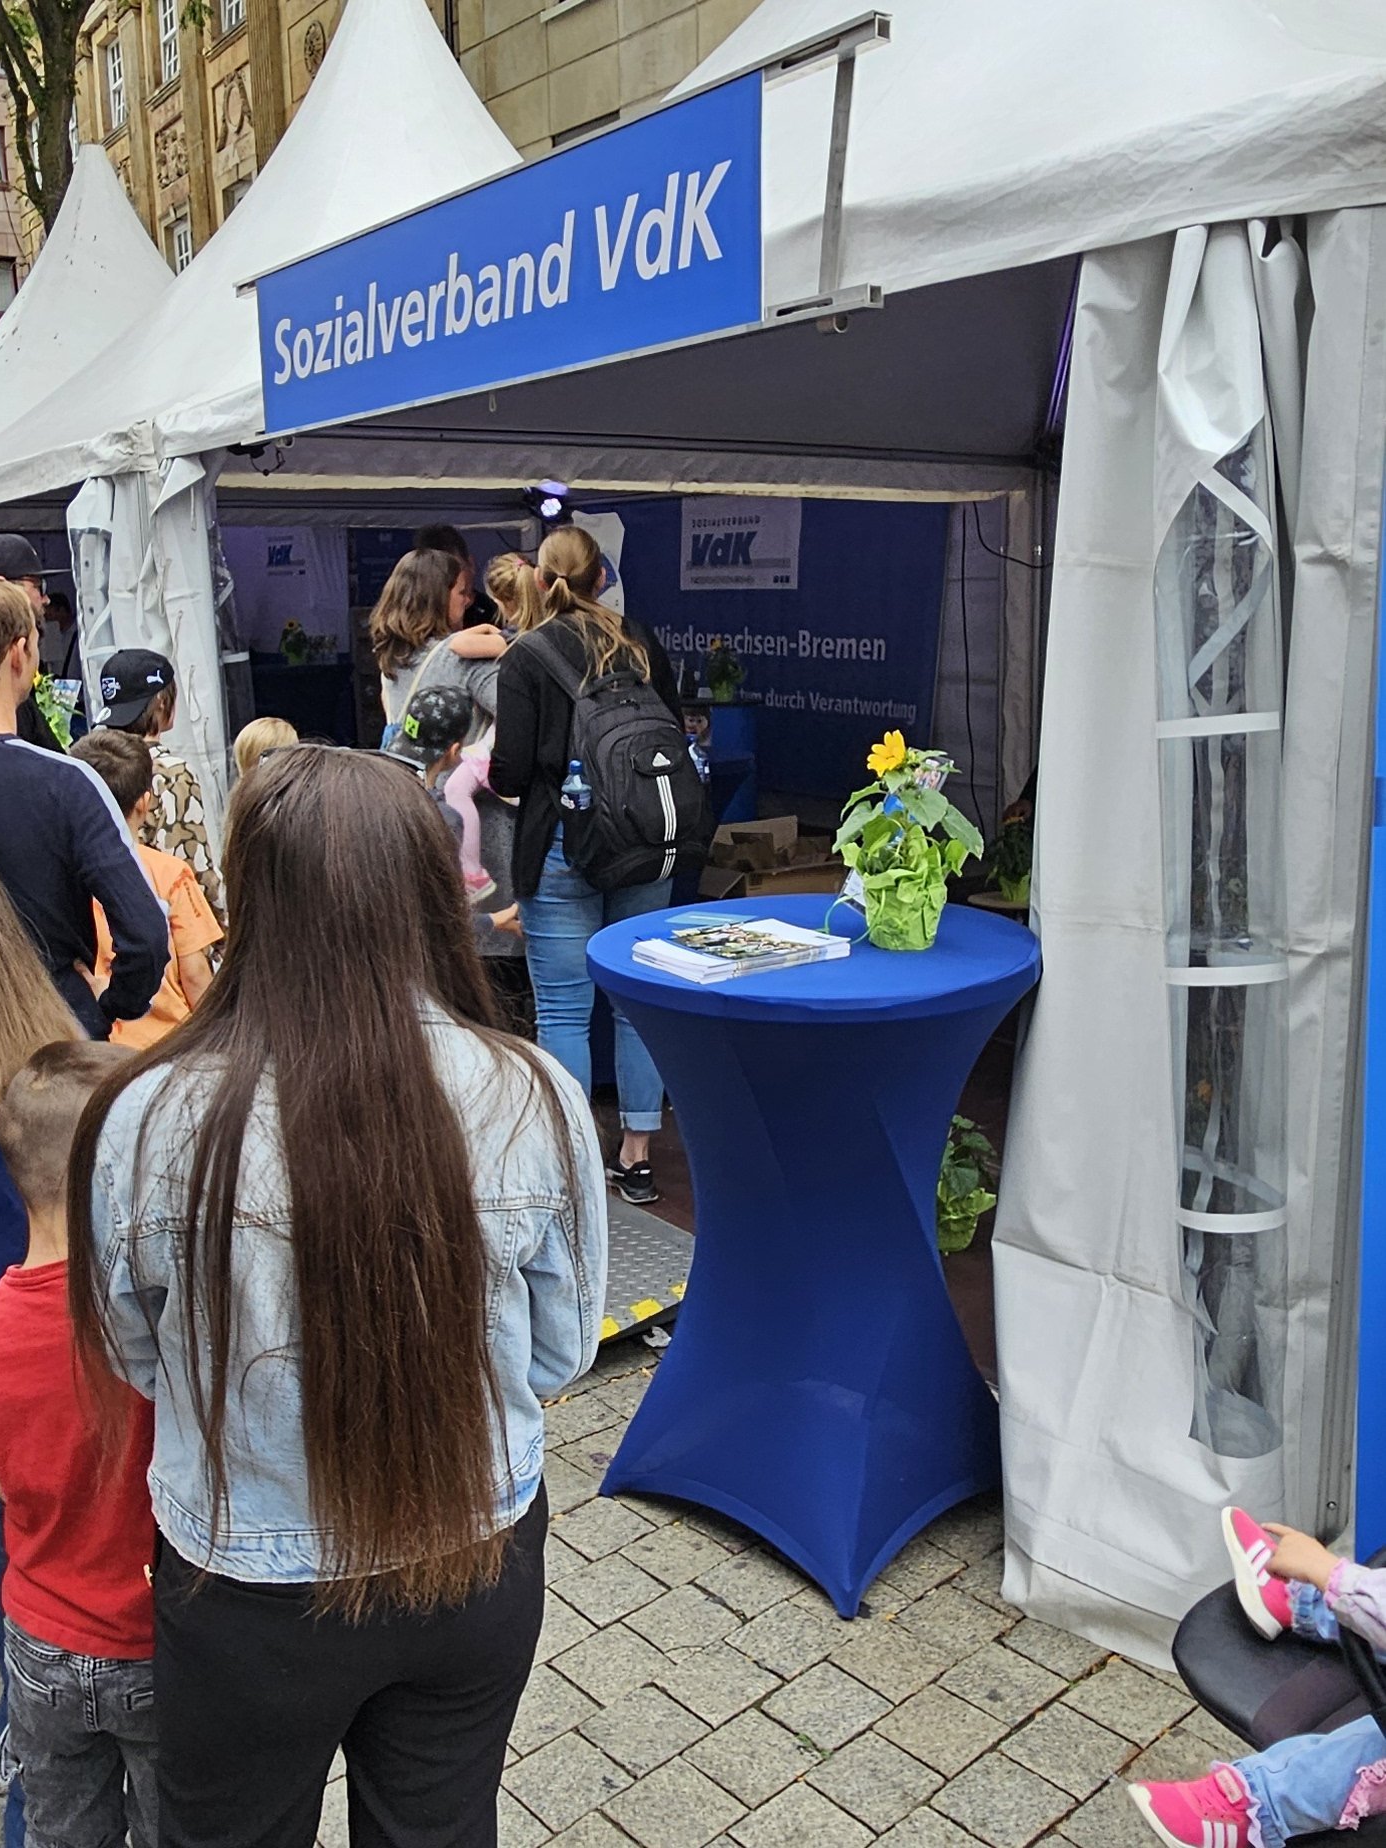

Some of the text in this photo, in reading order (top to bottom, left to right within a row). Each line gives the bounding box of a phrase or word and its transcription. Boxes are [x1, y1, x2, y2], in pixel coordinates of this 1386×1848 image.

[274, 159, 733, 386] Sozialverband VdK
[691, 530, 758, 566] VdK
[653, 624, 887, 662] Niederachsen-Bremen
[765, 688, 805, 710] durch
[809, 691, 917, 725] Verantwortung
